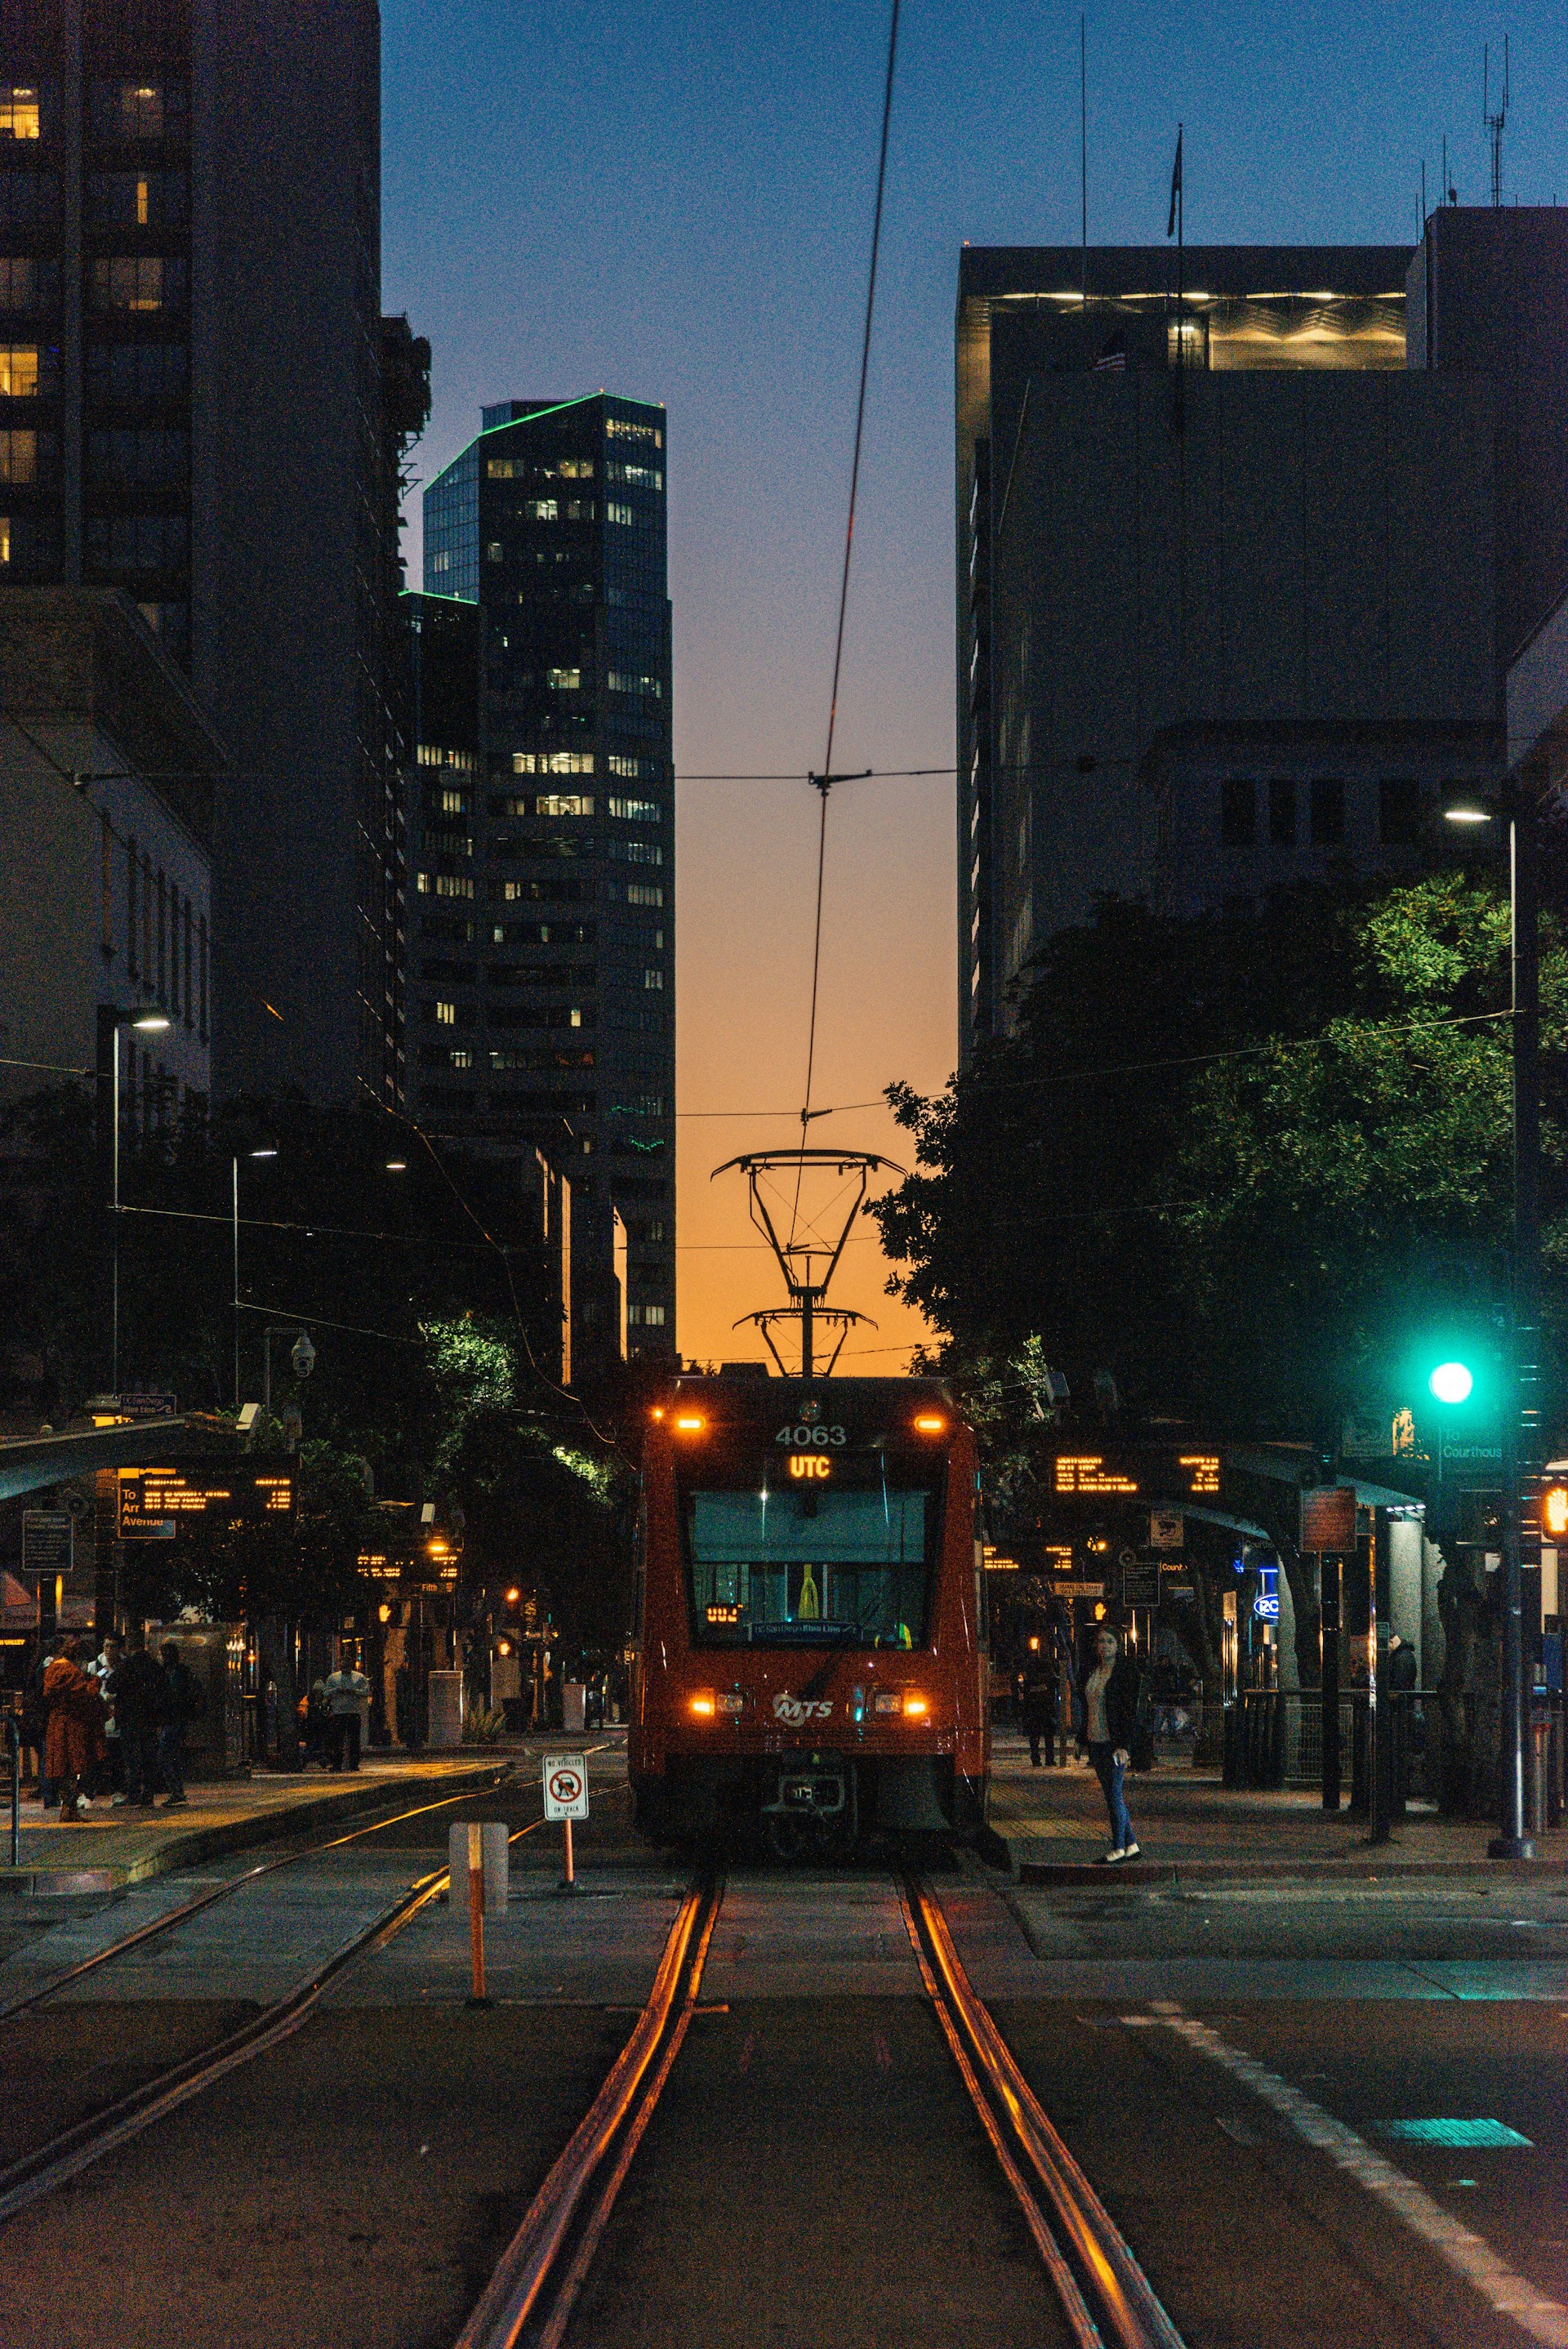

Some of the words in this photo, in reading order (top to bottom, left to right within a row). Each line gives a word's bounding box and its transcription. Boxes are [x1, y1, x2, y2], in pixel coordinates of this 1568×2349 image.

[775, 1425, 847, 1446] 4063
[1443, 1445, 1502, 1458] Courthous
[790, 1455, 830, 1478] UTC
[122, 1489, 136, 1500] To
[122, 1516, 163, 1526] Avenue
[422, 1583, 438, 1592] Fifth
[774, 1700, 834, 1718] MTS
